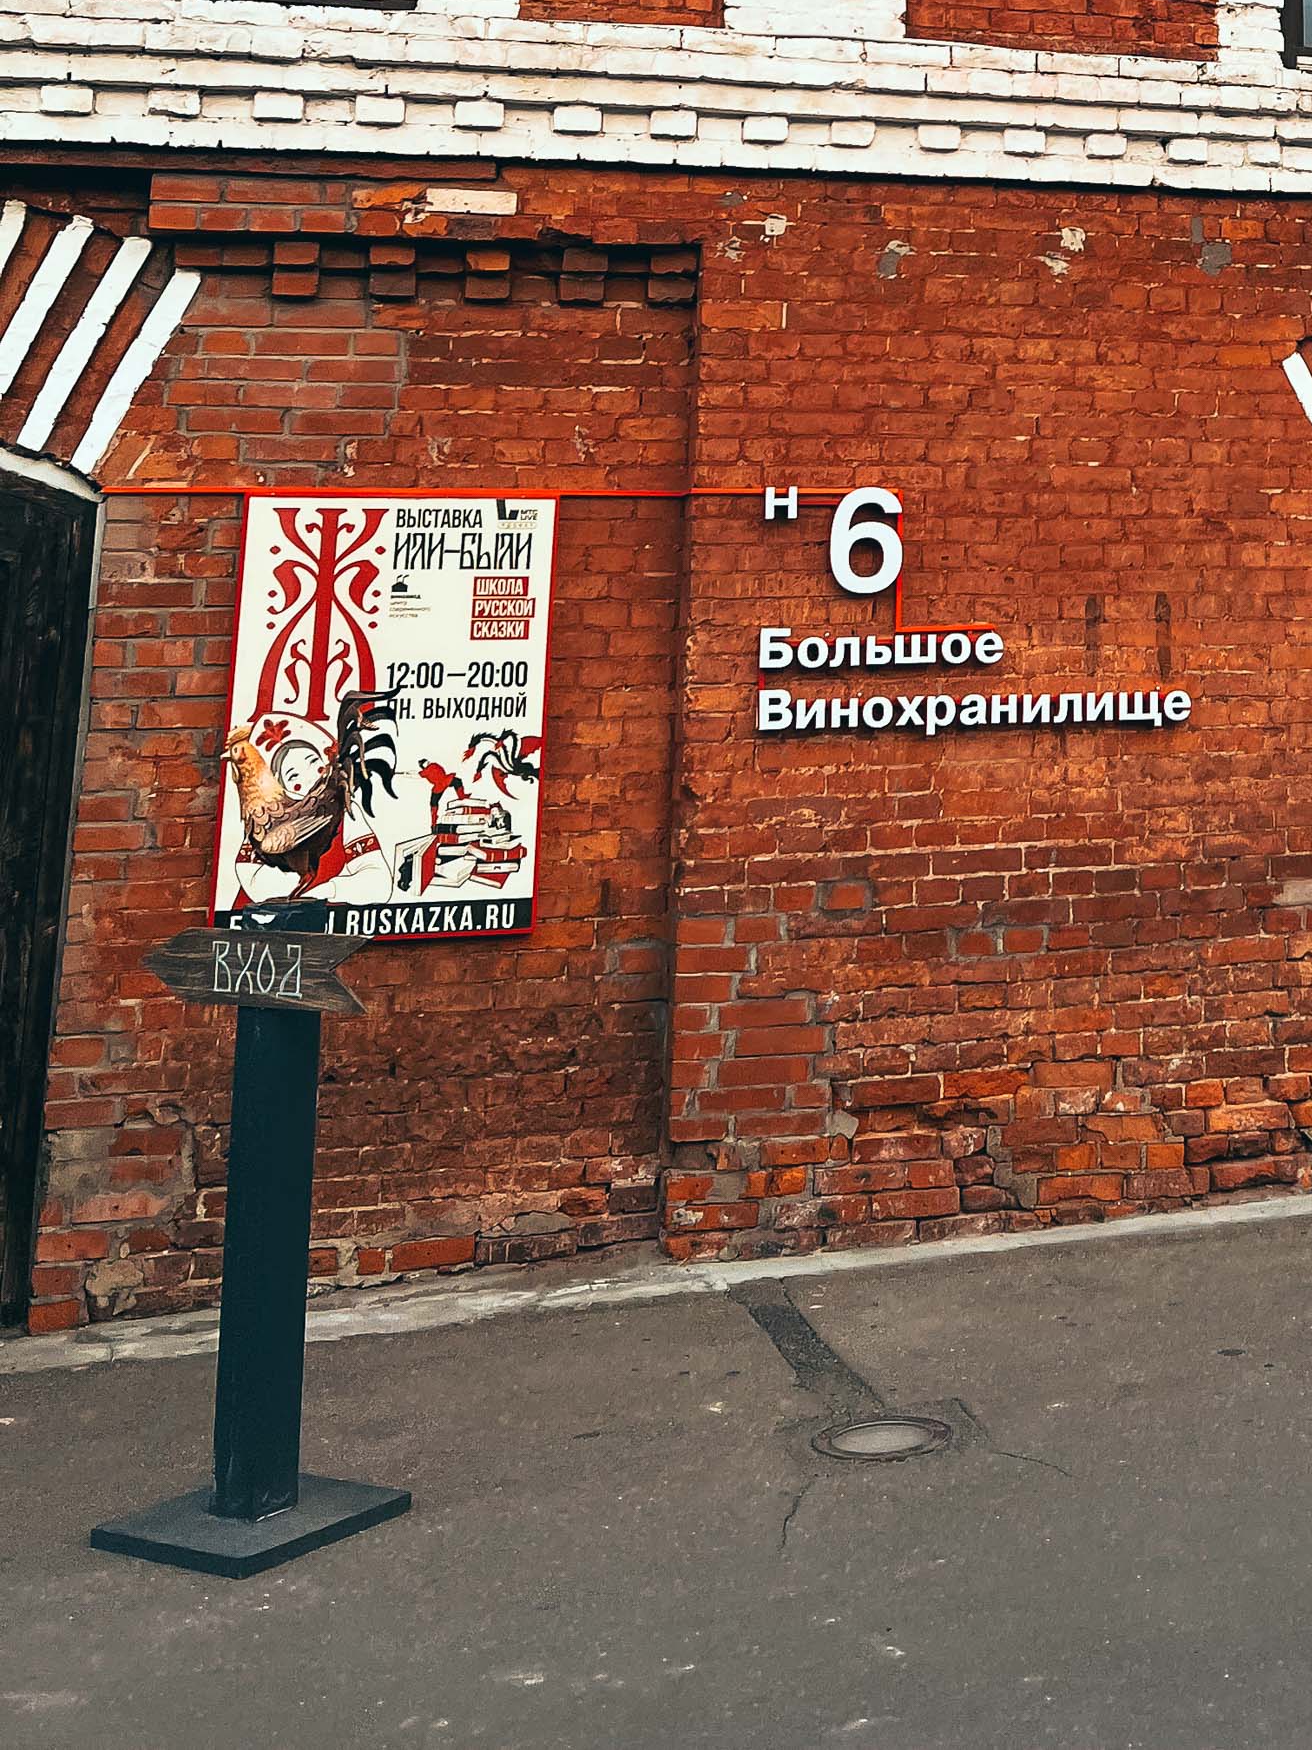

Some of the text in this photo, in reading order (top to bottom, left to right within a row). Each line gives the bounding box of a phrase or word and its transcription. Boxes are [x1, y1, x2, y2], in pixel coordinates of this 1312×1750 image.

[395, 508, 483, 529] ВЫСТАВКА
[829, 486, 904, 595] 6
[475, 578, 524, 596] ШКОЛА
[474, 598, 534, 617] РУССКОЙ
[473, 620, 525, 638] СКАЗКИ
[758, 627, 1004, 669] Большое
[423, 691, 528, 721] ВЫХОДНОЙ
[758, 688, 1192, 736] Винохранилище
[346, 903, 515, 936] RUSKAZKA.RU
[211, 941, 303, 999] ВХОД
